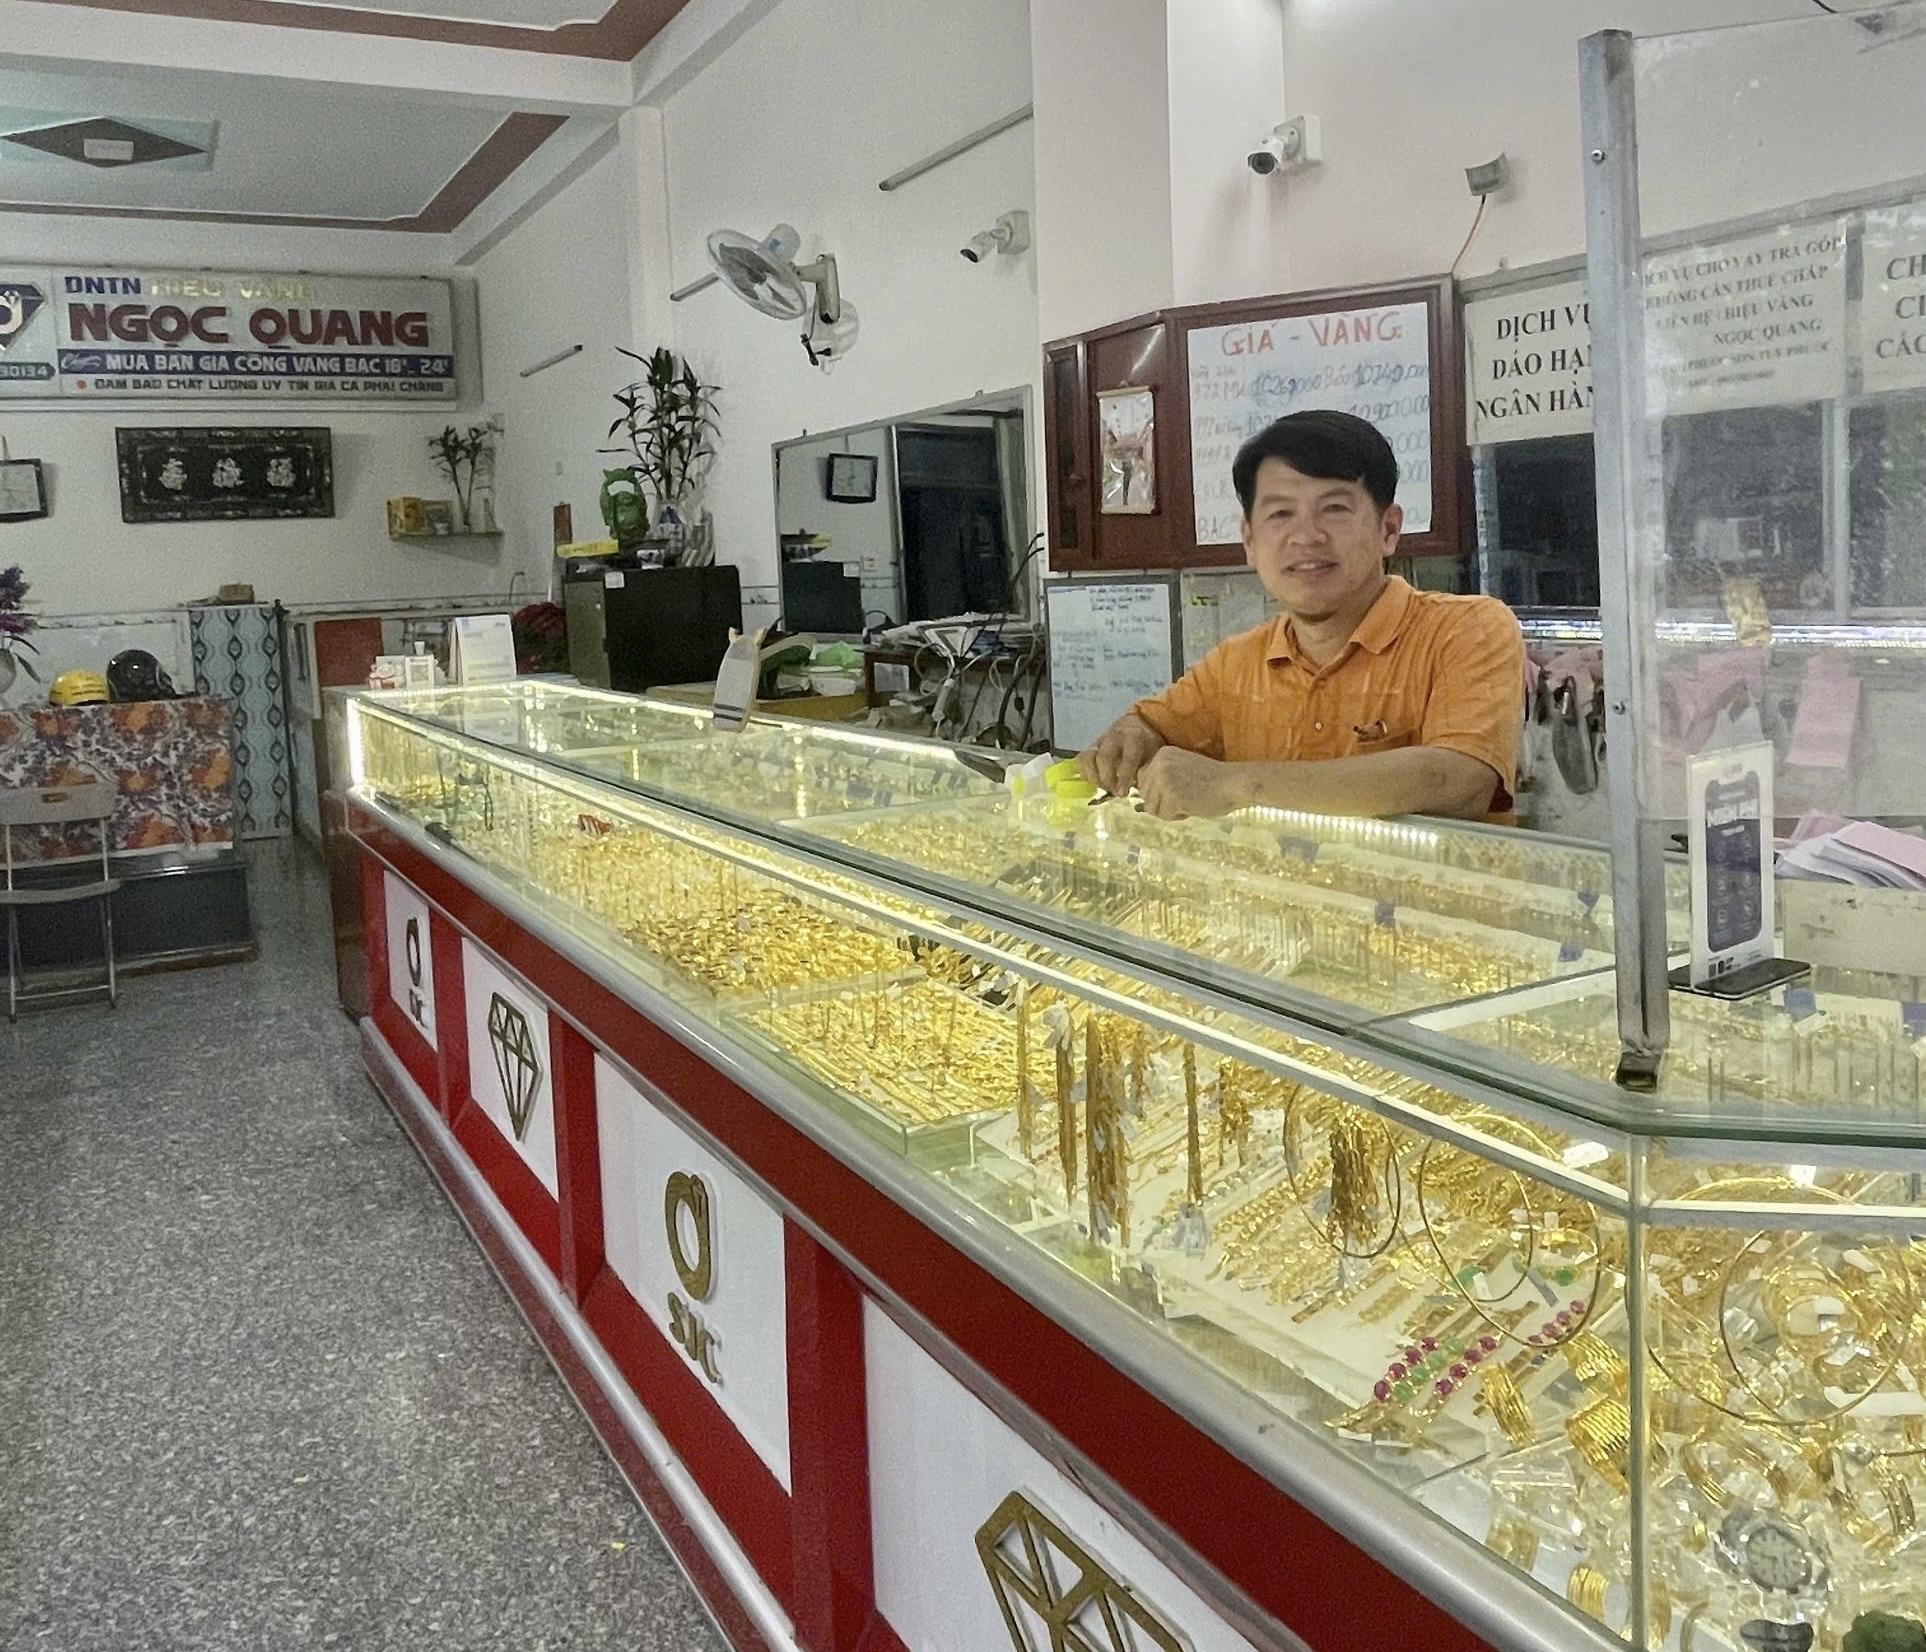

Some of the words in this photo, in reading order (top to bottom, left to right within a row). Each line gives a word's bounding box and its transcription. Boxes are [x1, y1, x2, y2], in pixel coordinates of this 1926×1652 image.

[65, 276, 141, 294] DNTN
[250, 308, 429, 349] QUANG
[1497, 308, 1556, 343] DỊCH
[106, 353, 149, 371] MUA
[1476, 387, 1542, 419] NGÂN
